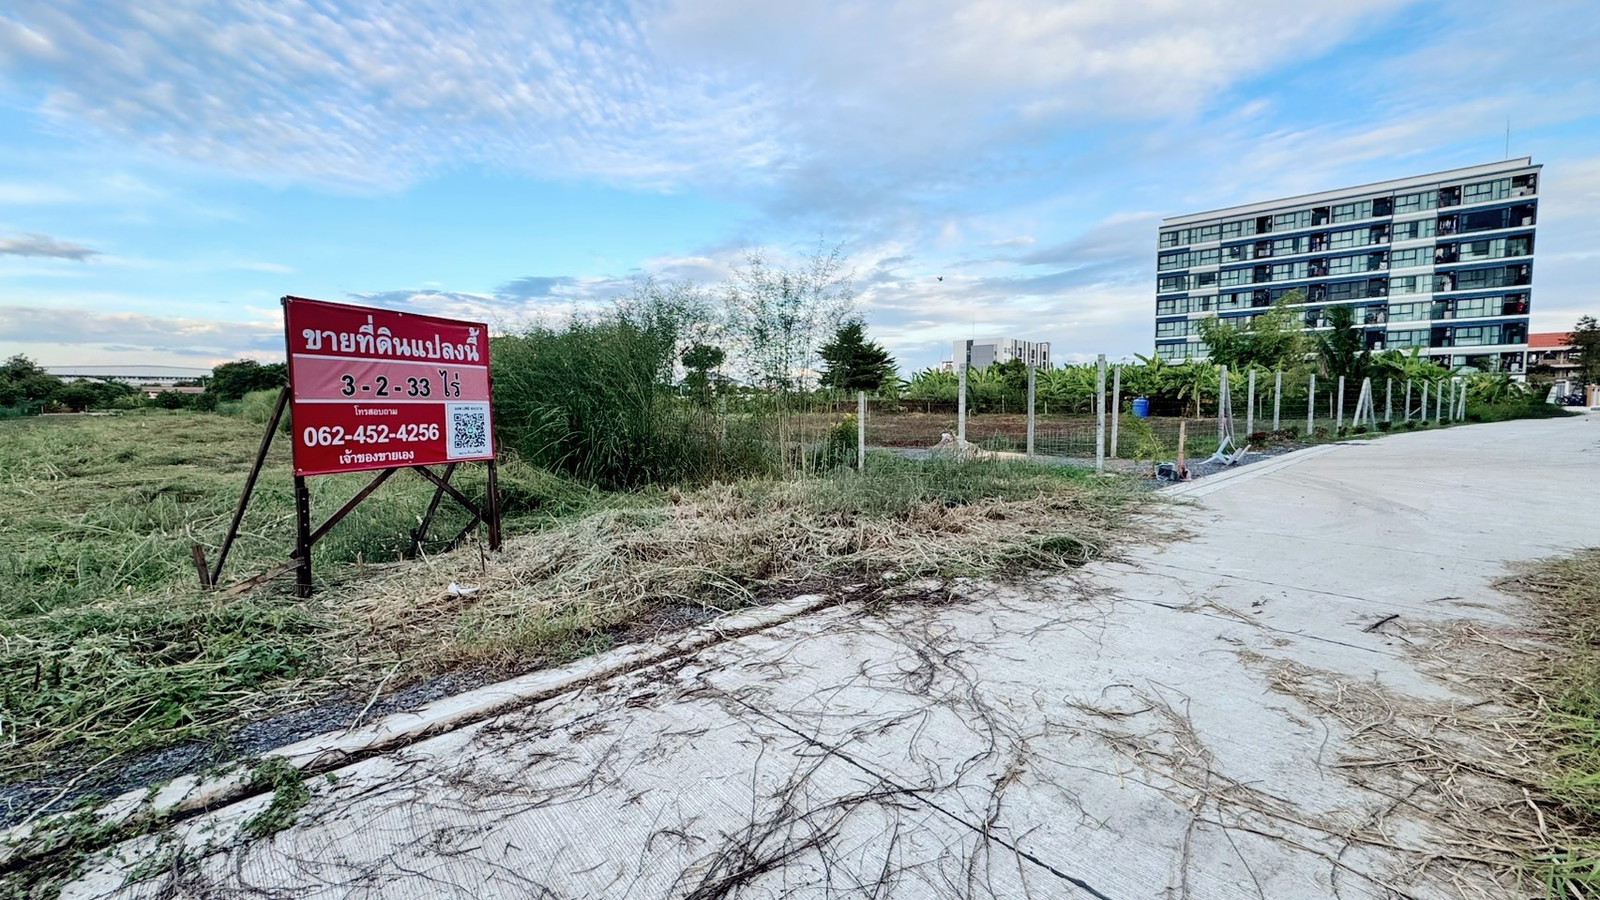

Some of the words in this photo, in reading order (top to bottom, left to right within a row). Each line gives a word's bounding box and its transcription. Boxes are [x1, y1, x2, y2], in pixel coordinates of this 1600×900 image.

[302, 315, 480, 362] ขายที่ดินแปลงนี้
[438, 370, 461, 399] ไร่
[353, 405, 398, 416] โทรสอบถาม
[303, 423, 440, 447] 062-452-4256
[339, 449, 415, 465] เจ้าของขายเอง
